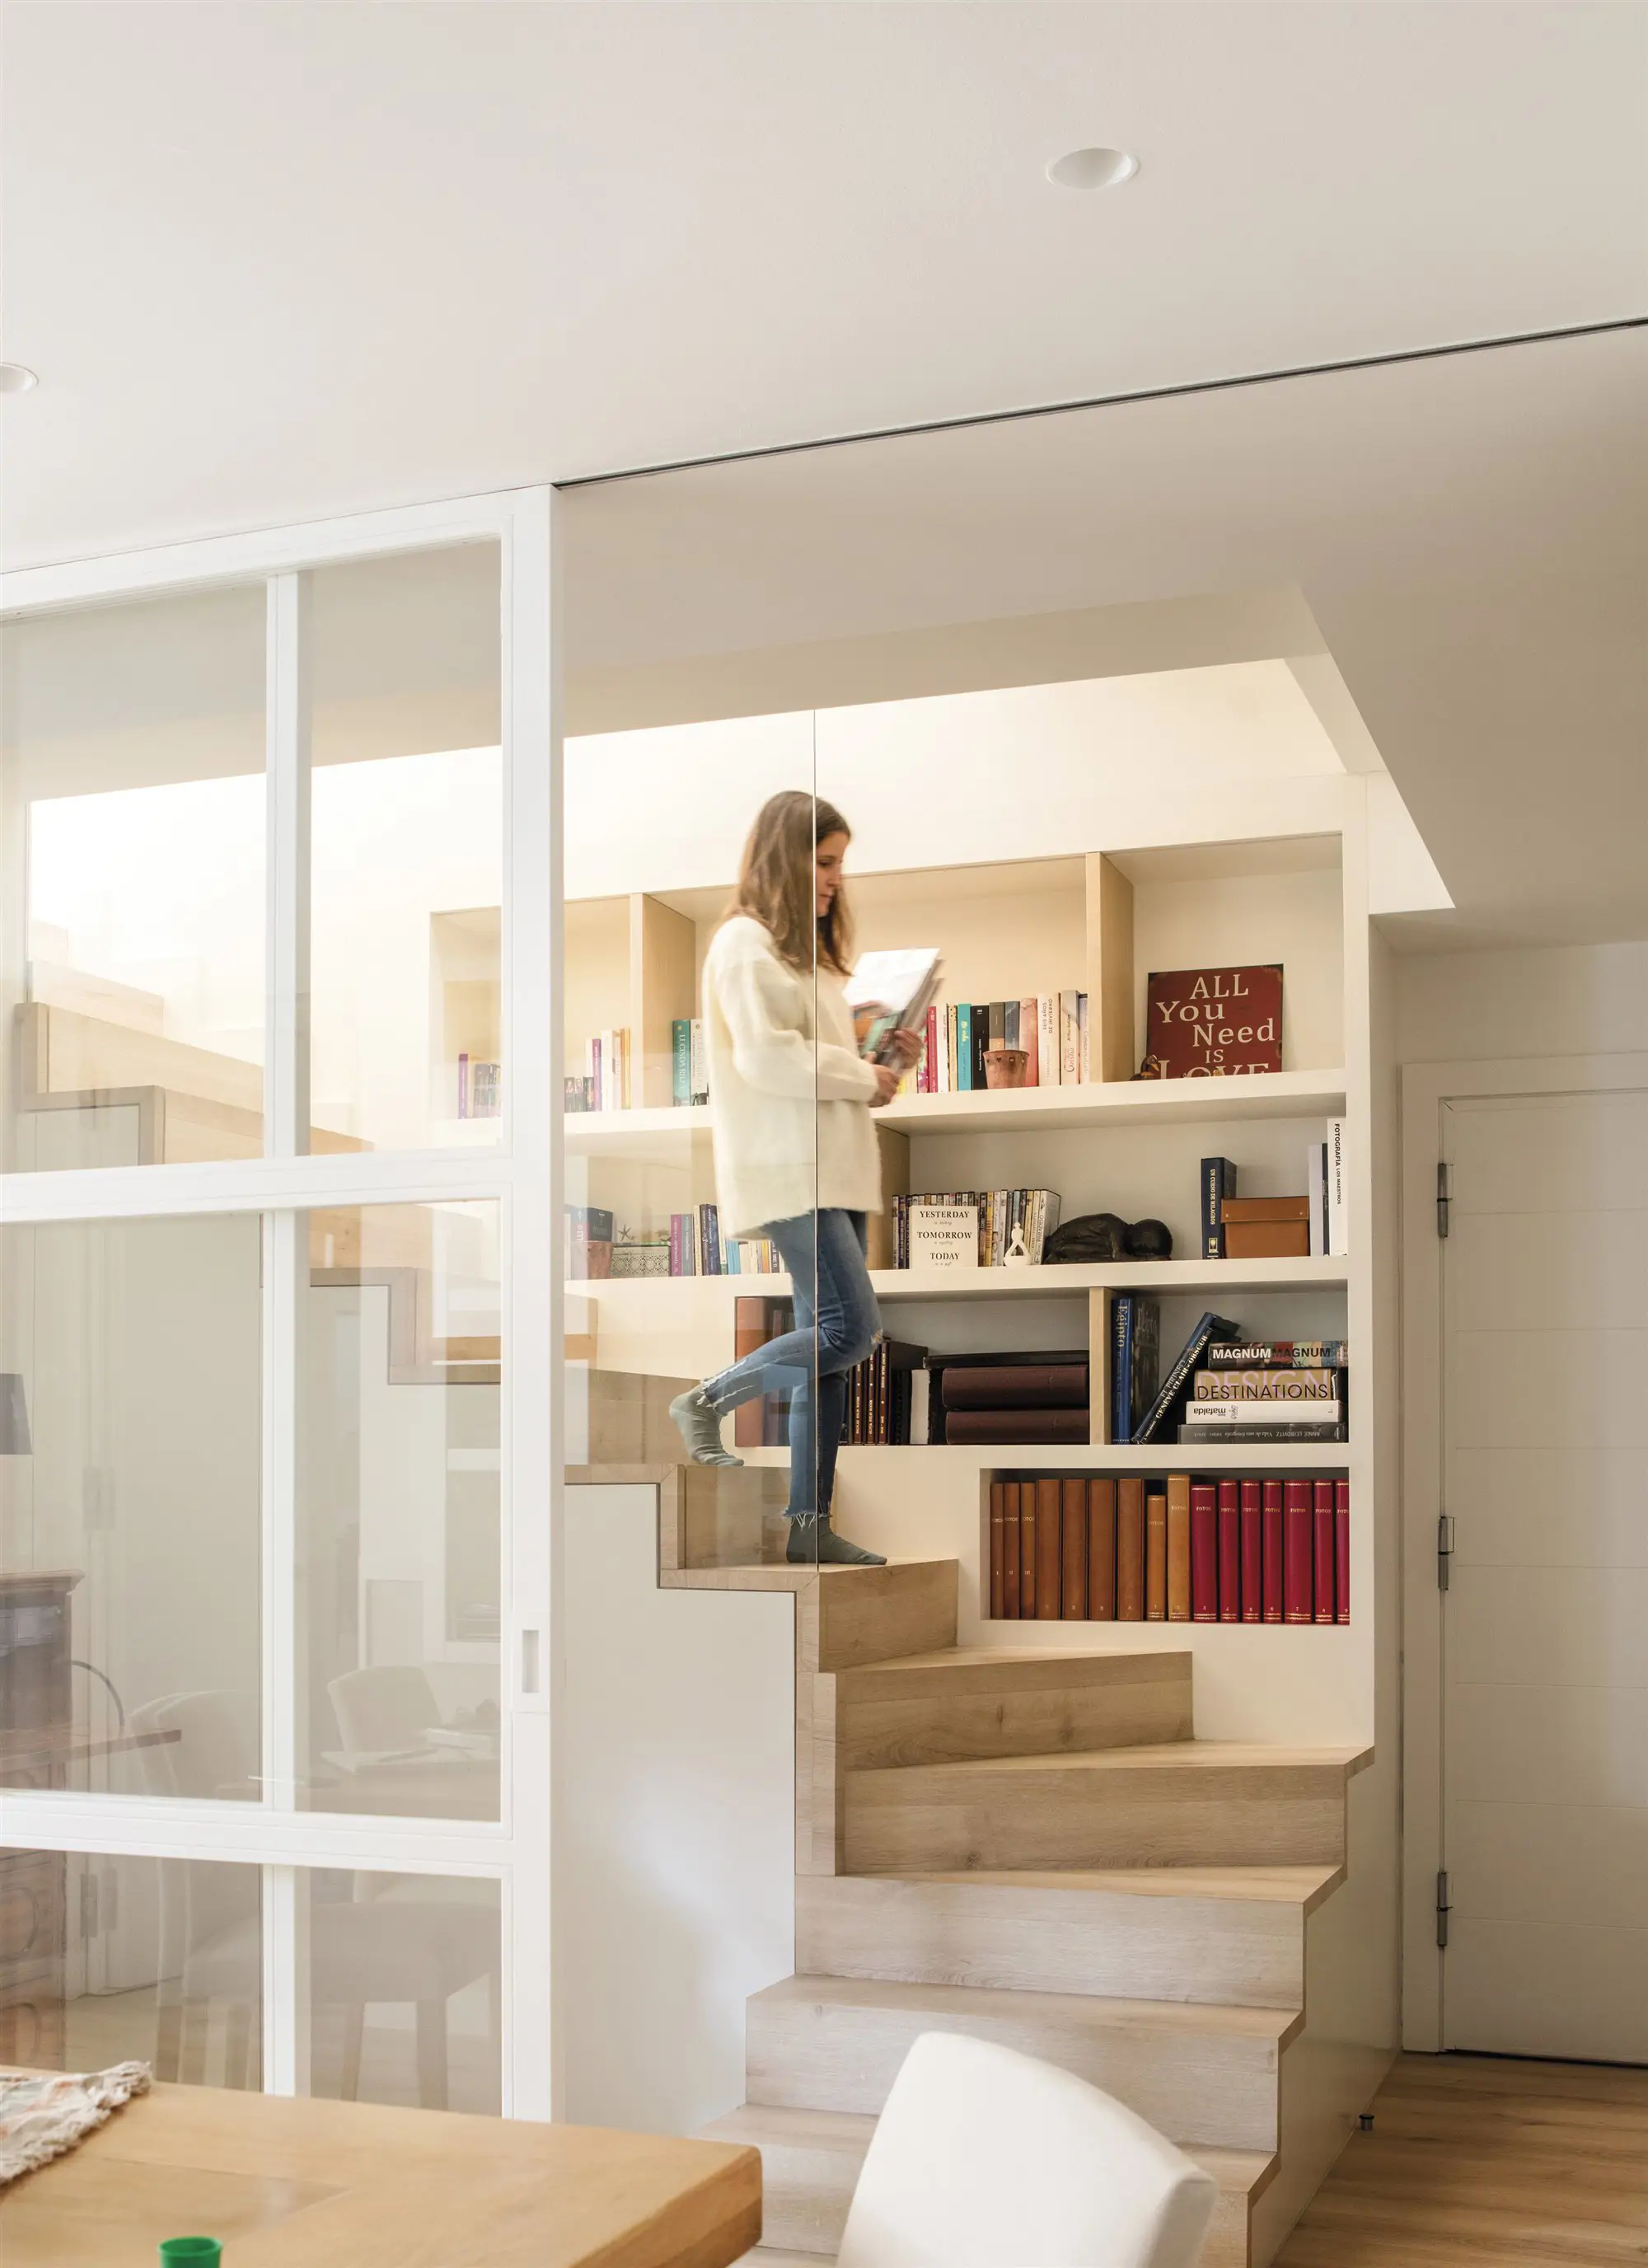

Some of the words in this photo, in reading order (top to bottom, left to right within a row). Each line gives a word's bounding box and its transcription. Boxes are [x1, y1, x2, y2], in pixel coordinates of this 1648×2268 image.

[1189, 974, 1249, 1000] ALL
[1156, 1001, 1225, 1024] You
[1192, 1018, 1276, 1047] Need
[1205, 1049, 1224, 1064] IS
[1116, 1305, 1127, 1347] Egipto
[1213, 1348, 1271, 1359] MAGNUM
[1271, 1347, 1331, 1358] MAGNUM
[1197, 1370, 1328, 1399] DESIGN
[1197, 1384, 1328, 1399] DESTINATIONS
